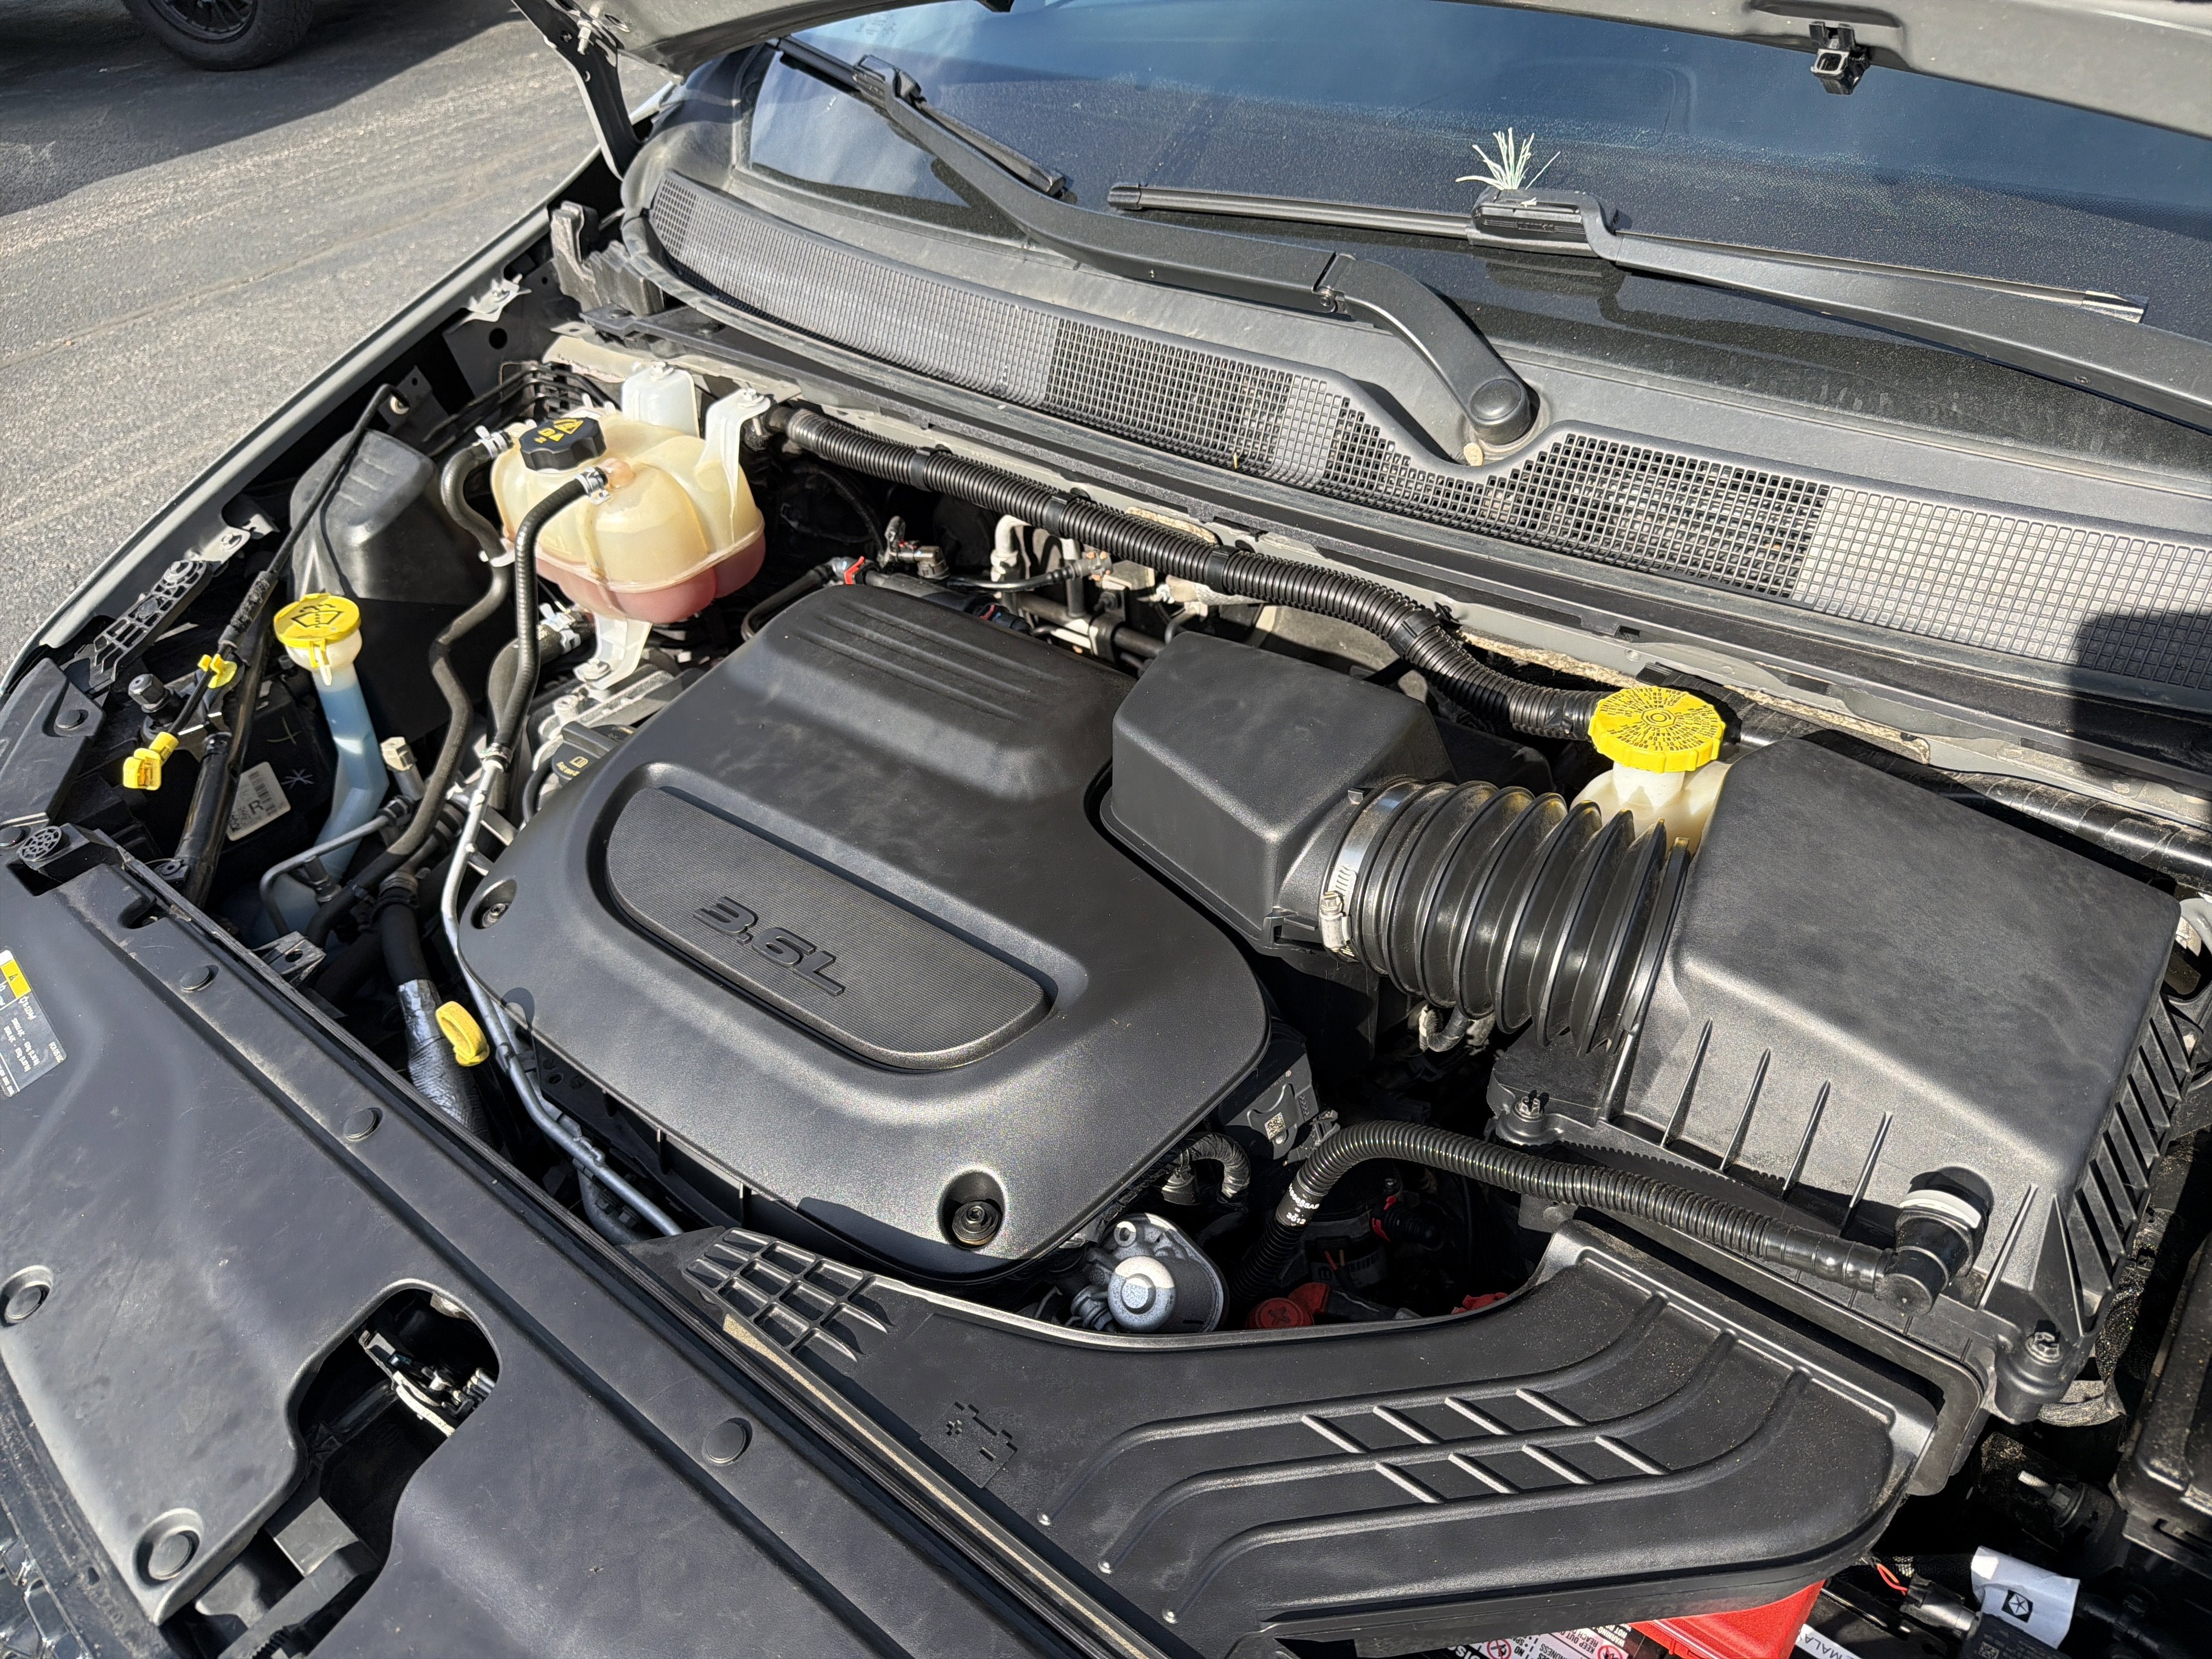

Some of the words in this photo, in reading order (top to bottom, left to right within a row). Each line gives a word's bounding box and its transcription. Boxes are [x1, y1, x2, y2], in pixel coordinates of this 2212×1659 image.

[693, 896, 845, 996] 3.6L
[1565, 1633, 1579, 1644] OUT
[1577, 1630, 1599, 1646] REACH
[1514, 1646, 1525, 1657] NO
[1579, 1641, 1595, 1655] KEEP
